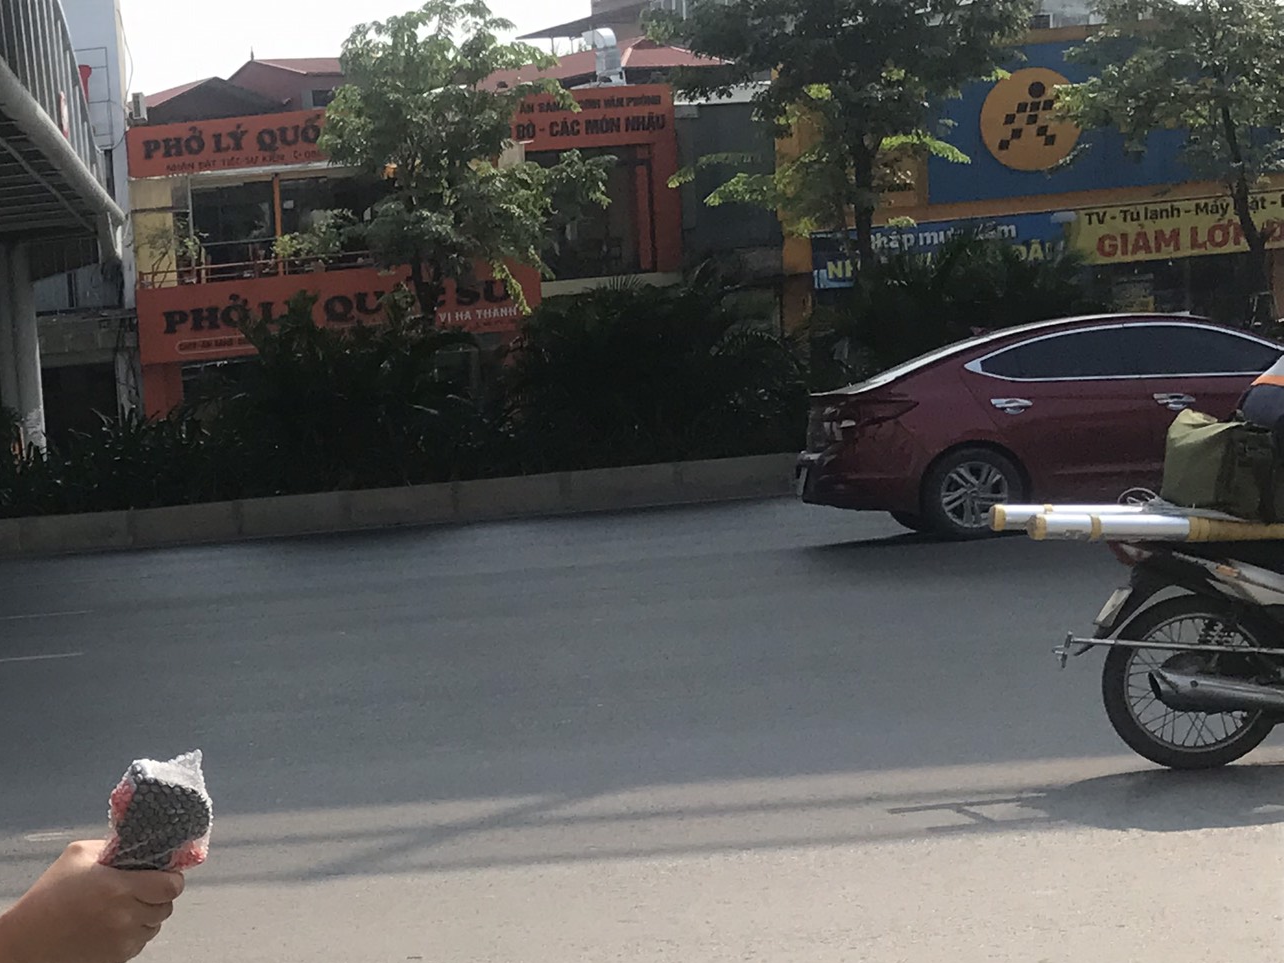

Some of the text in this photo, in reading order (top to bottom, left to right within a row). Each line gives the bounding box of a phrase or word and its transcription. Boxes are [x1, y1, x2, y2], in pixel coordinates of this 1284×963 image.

[142, 114, 322, 160] PHỞ LÝ QUỐ
[1085, 211, 1107, 225] TV
[1096, 223, 1180, 258] GIẢM
